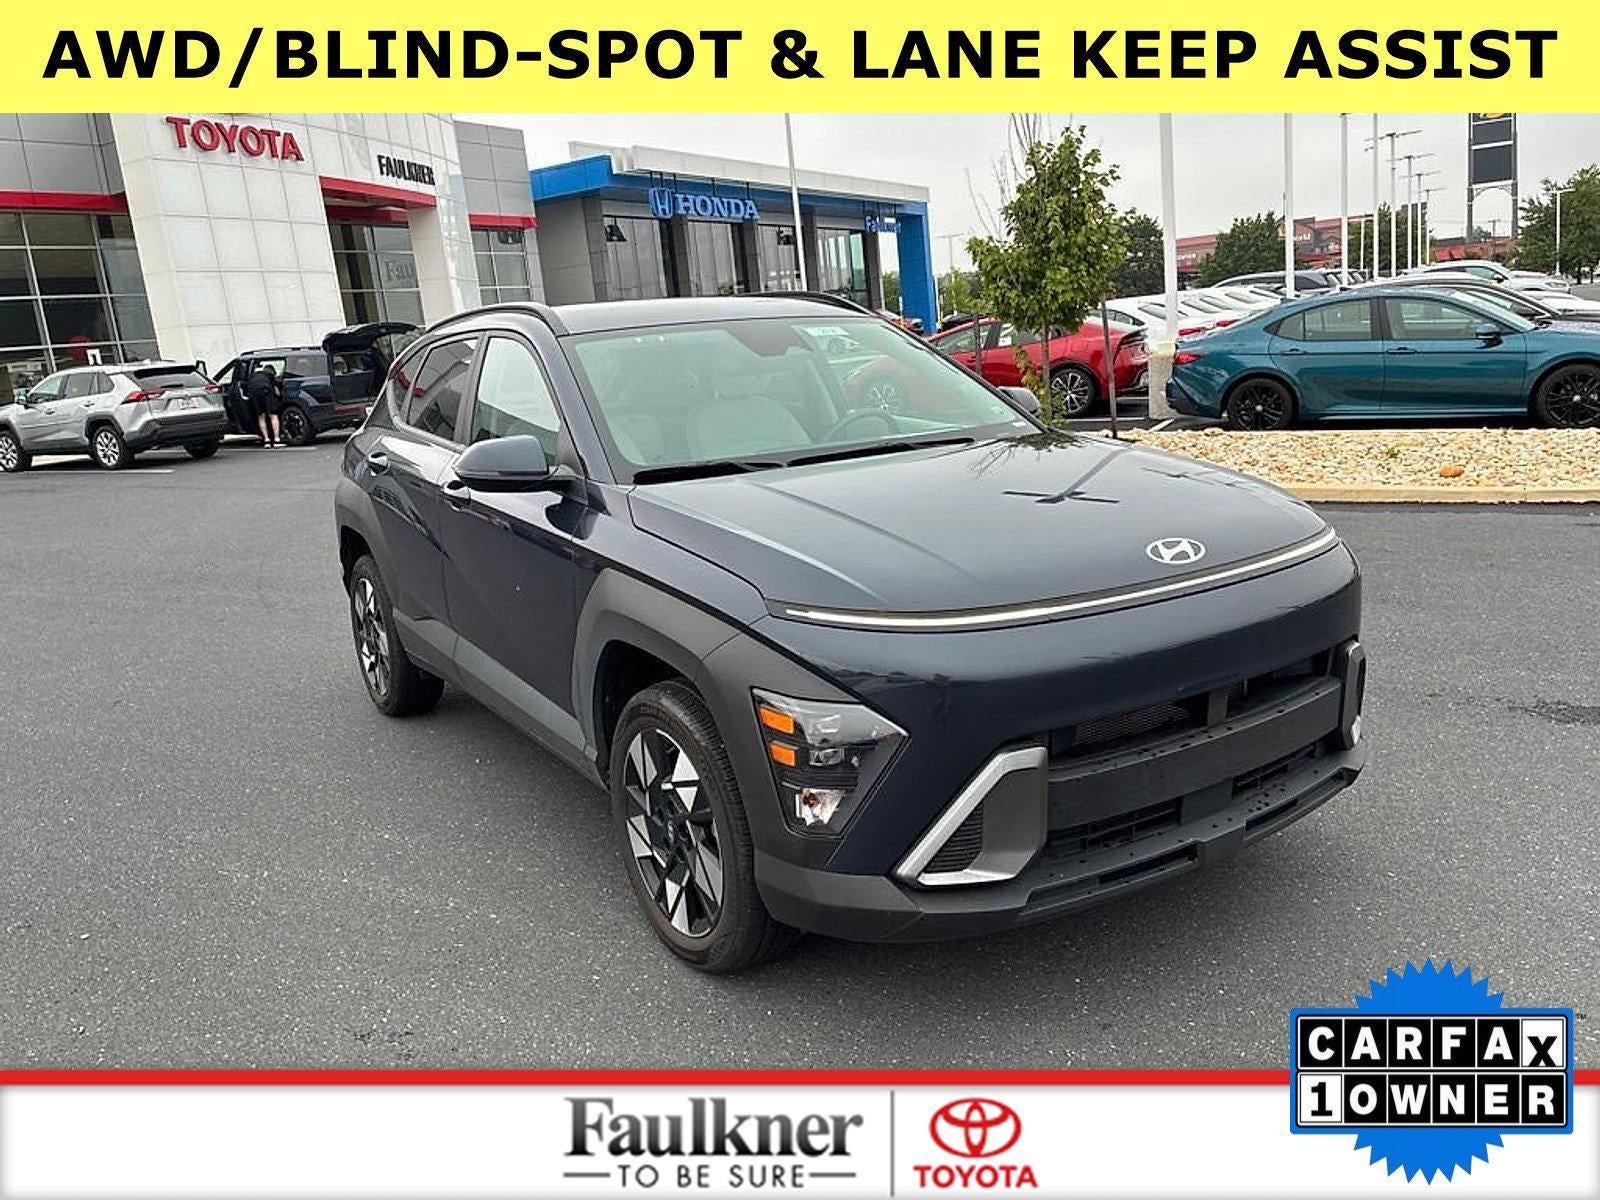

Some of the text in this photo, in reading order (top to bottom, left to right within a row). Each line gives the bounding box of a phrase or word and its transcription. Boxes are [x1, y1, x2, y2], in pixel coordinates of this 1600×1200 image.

[165, 116, 304, 161] TOYOTA
[377, 154, 436, 186] FAULKNER
[674, 193, 760, 220] HONDA
